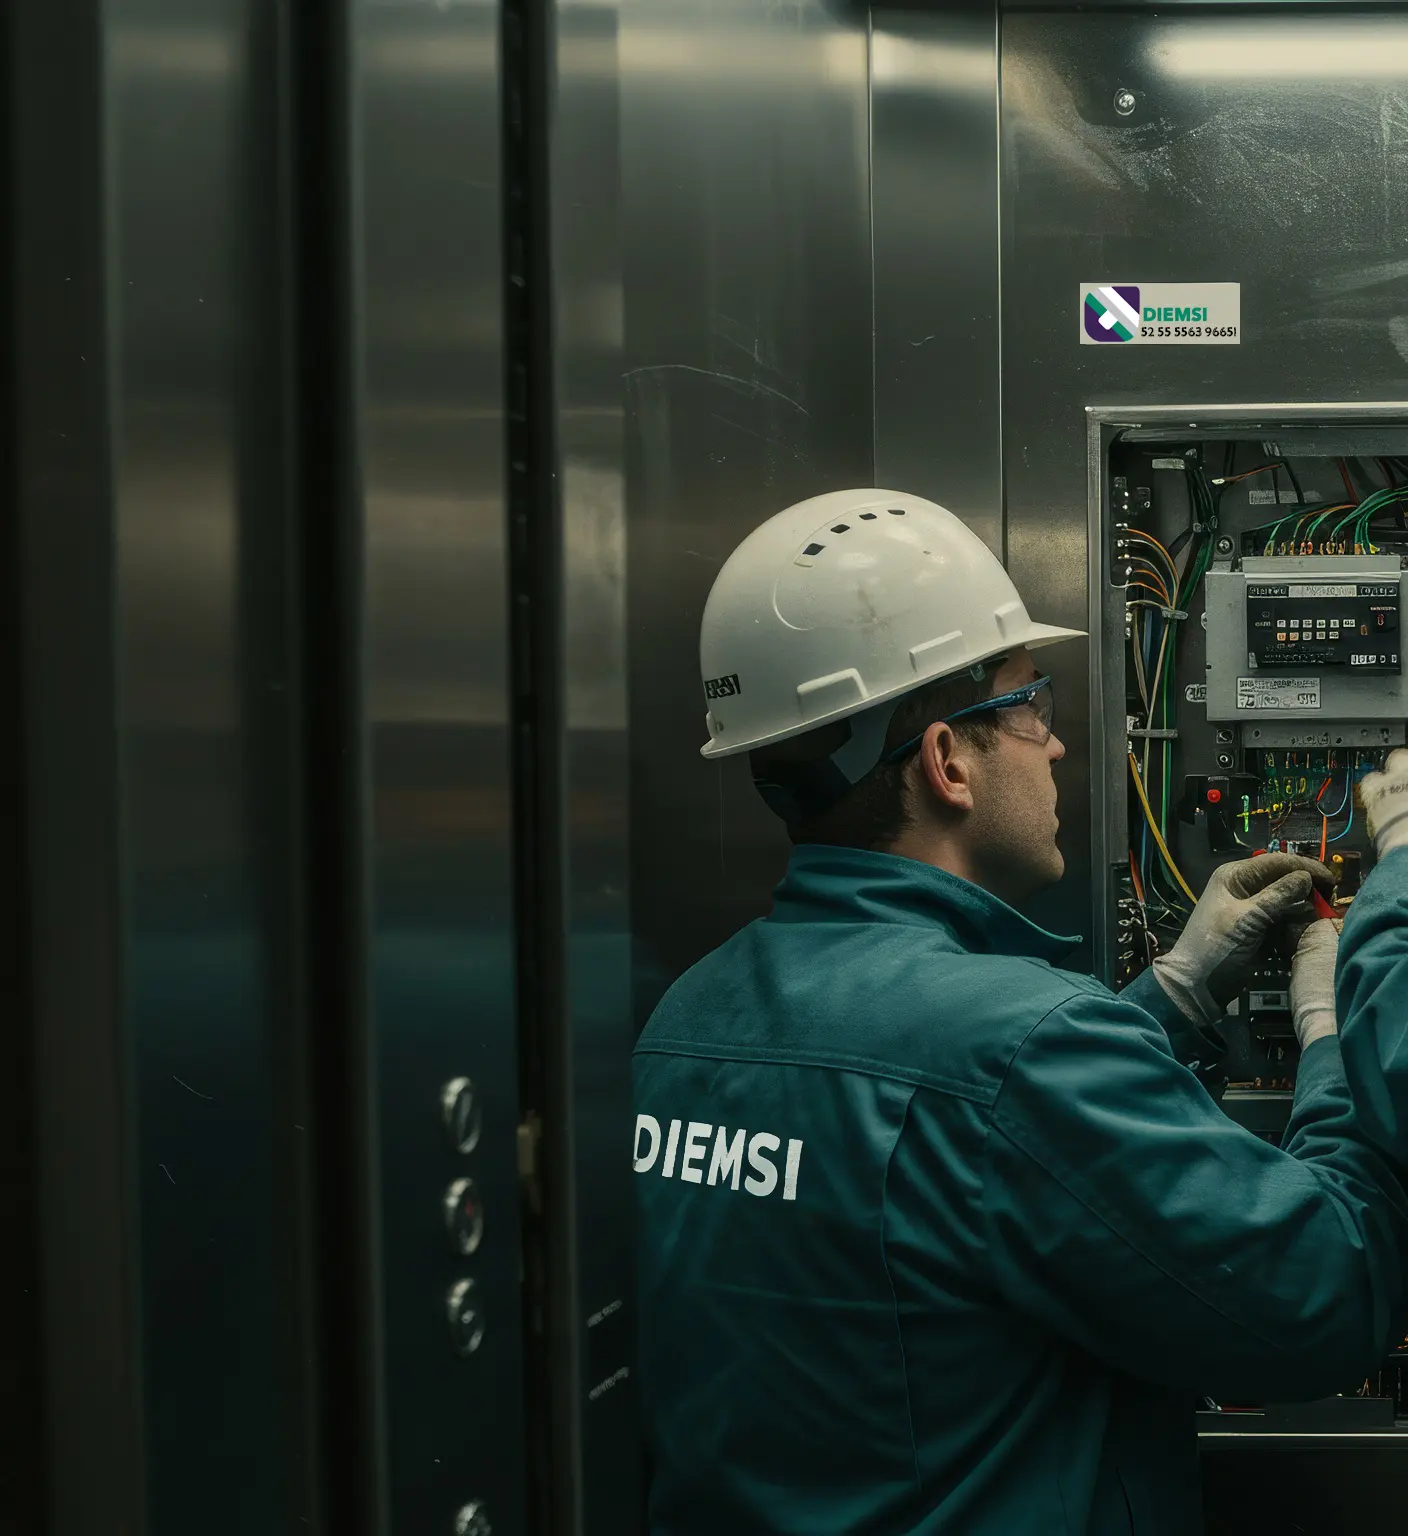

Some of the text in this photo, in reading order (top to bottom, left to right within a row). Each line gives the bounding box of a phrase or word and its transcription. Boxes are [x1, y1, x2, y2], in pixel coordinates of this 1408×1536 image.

[1143, 307, 1207, 322] DIEMSI
[1141, 326, 1155, 337] 52
[1157, 326, 1171, 337] 55
[1174, 326, 1202, 337] 5563
[632, 1113, 804, 1201] DIEMSI
